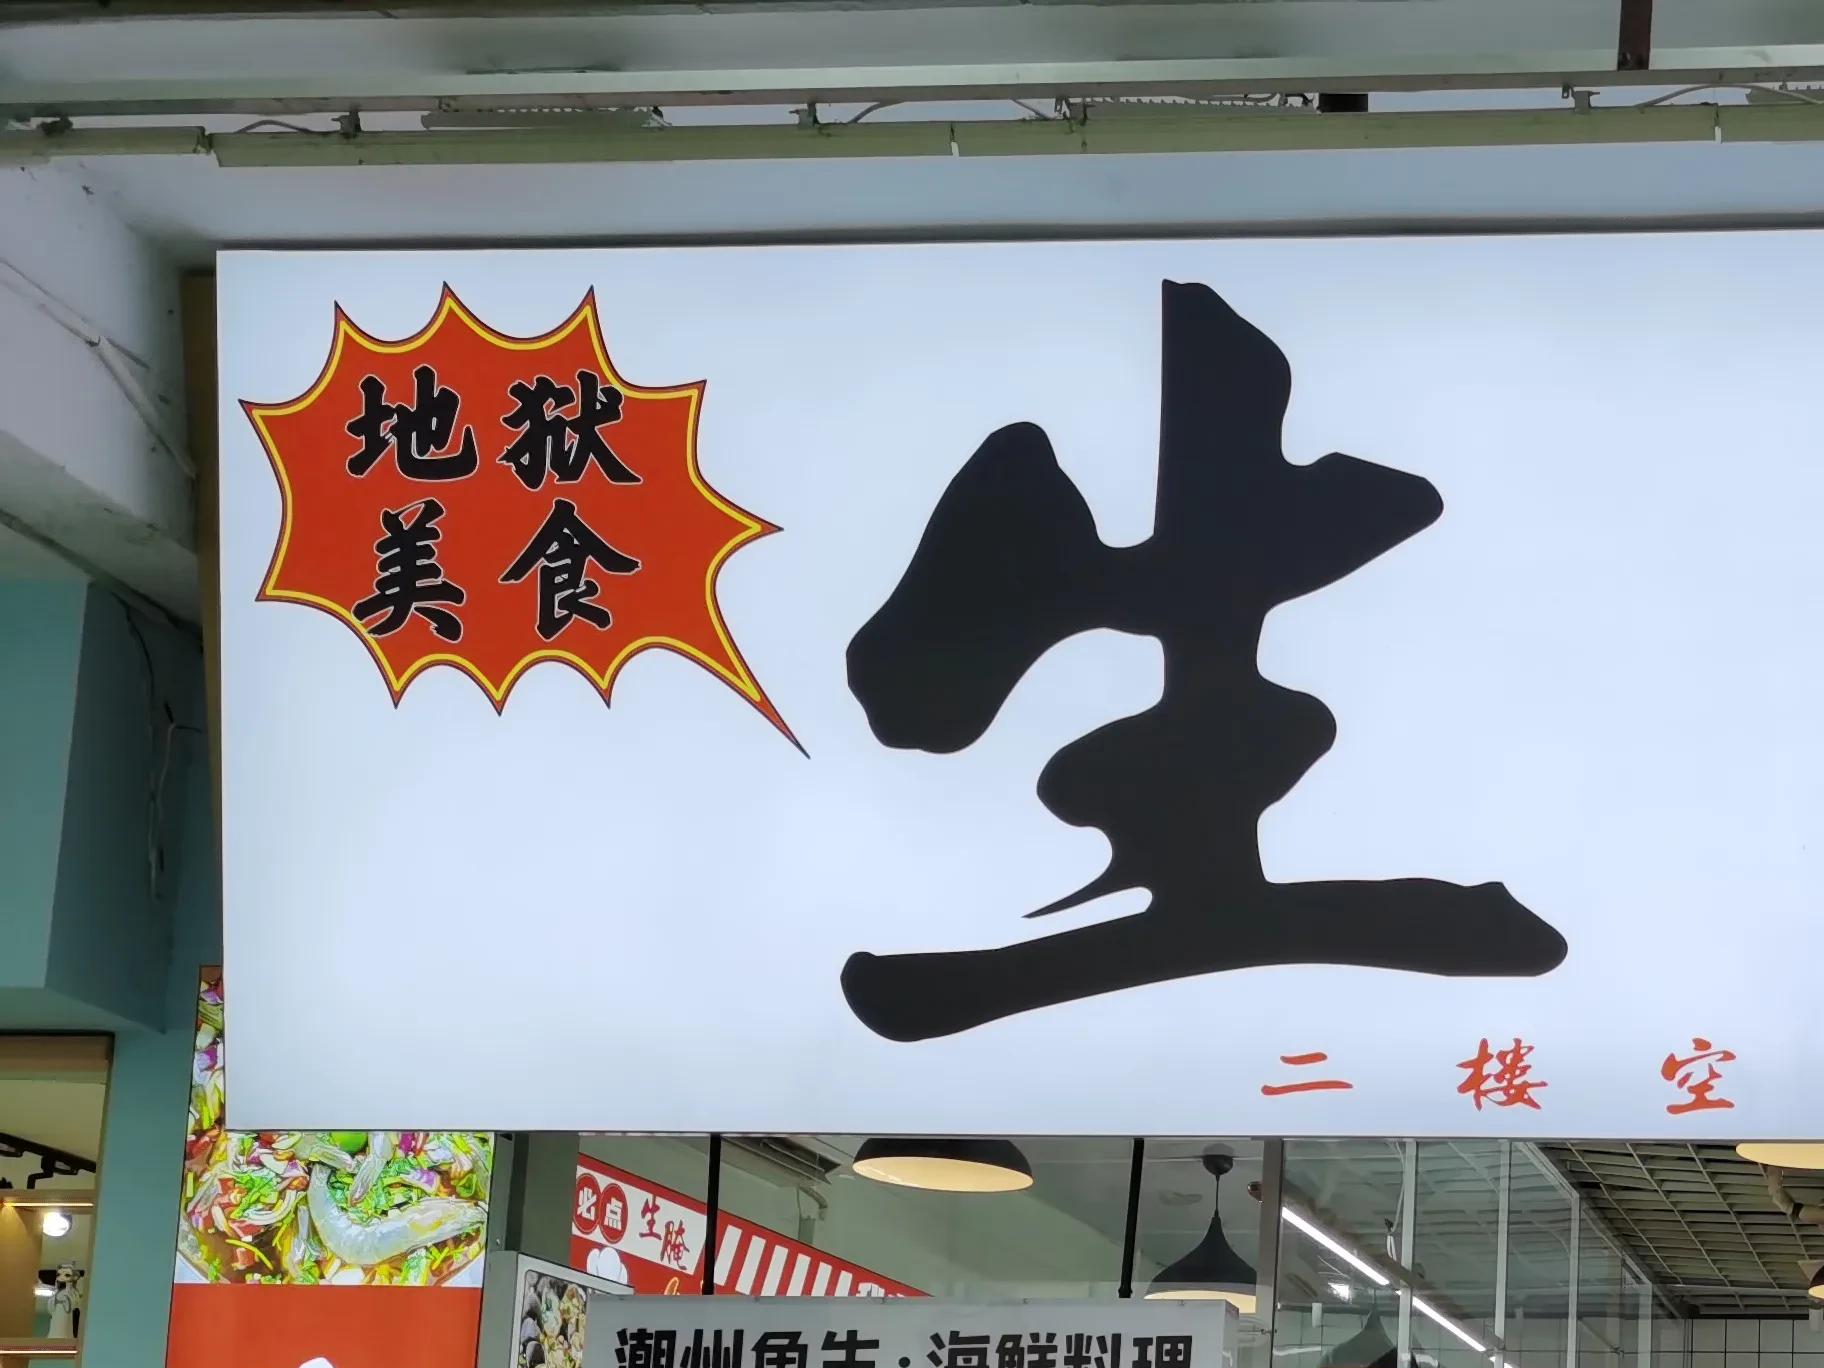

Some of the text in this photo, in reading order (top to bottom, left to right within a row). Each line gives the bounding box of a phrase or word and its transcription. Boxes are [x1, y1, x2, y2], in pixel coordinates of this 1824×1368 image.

[346, 365, 642, 490] 地狱
[351, 498, 641, 641] 美食
[576, 1186, 624, 1231] 必点
[638, 1195, 690, 1271] 生腌
